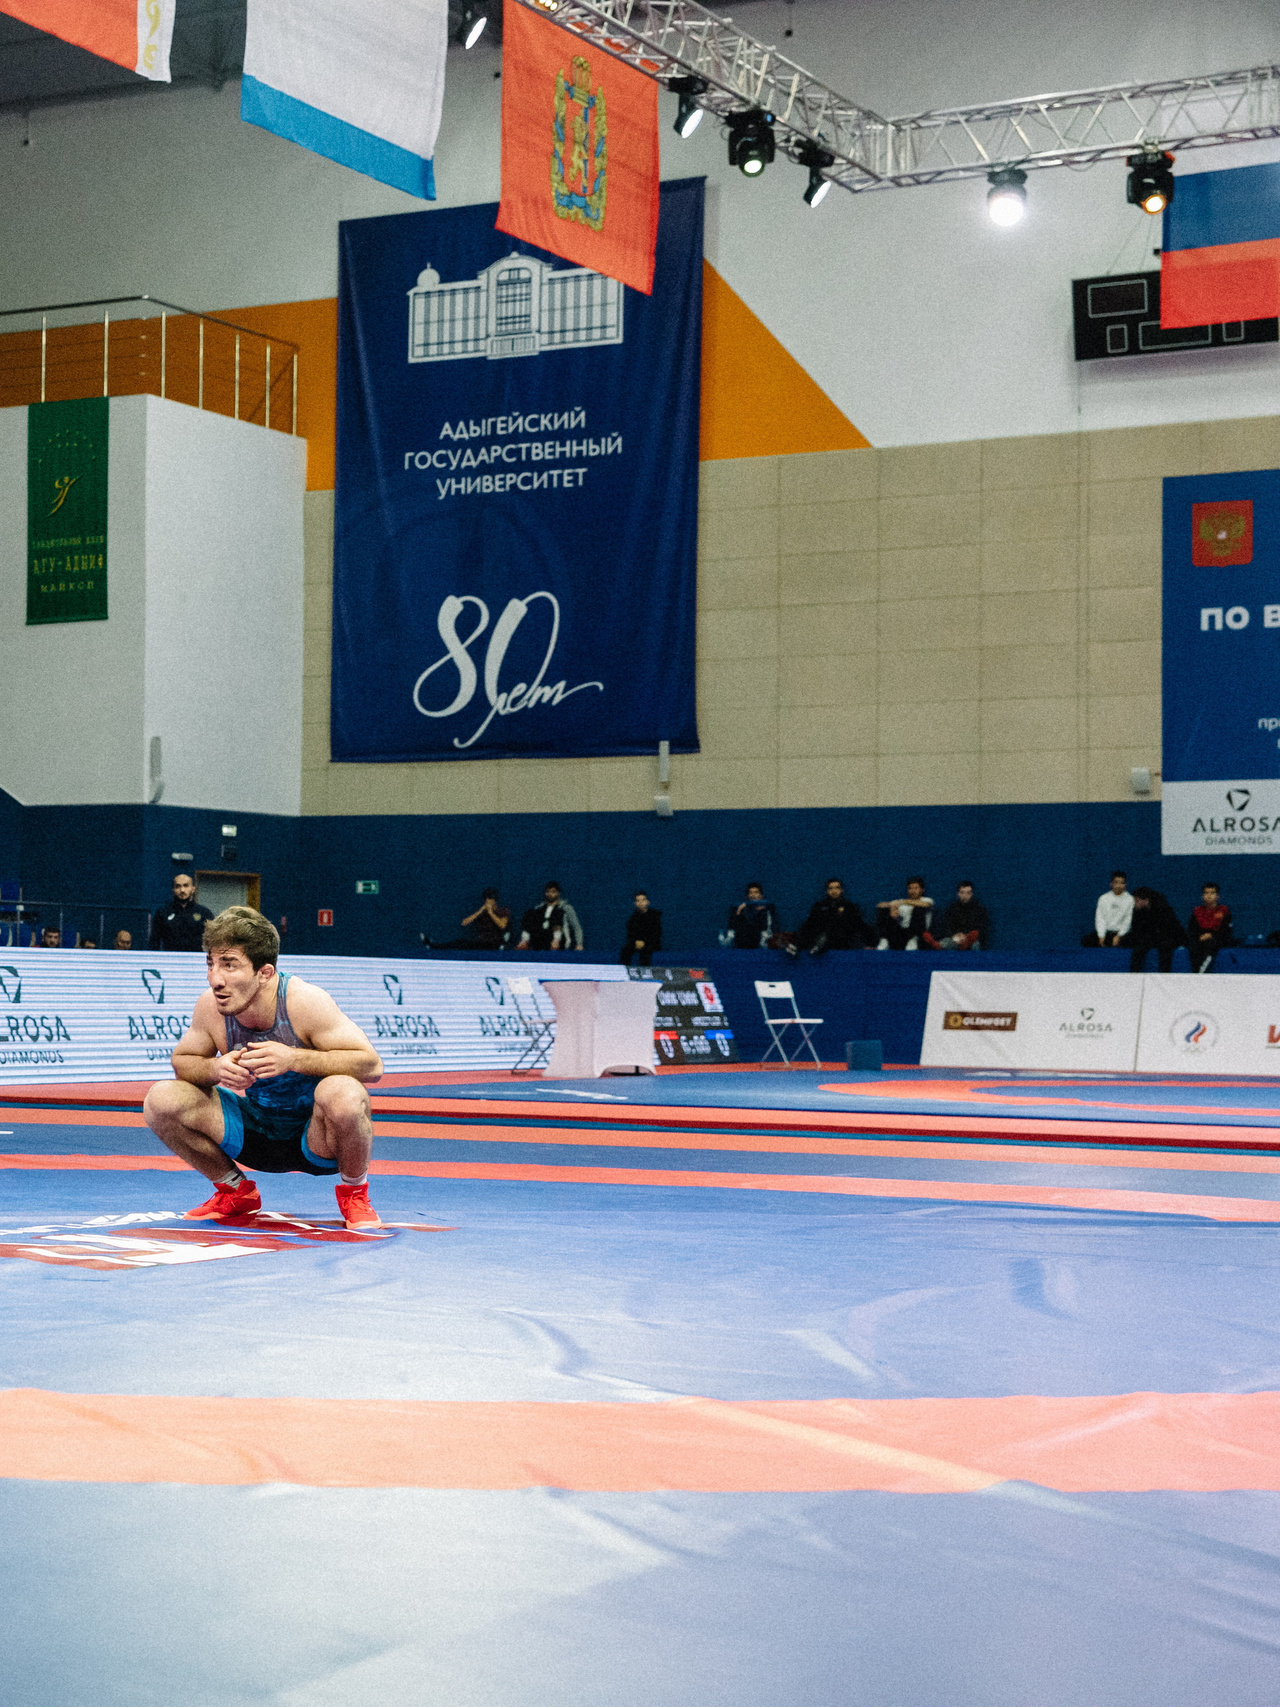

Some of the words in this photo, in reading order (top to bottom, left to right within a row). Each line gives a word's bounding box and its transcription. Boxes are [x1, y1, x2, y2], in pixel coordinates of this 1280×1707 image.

[439, 406, 586, 441] АДЫГЕЙСКИЙ
[404, 431, 623, 471] ГОСУДАРСТВЕННЫЙ
[436, 468, 588, 500] УНИВЕРСИТЕТ
[413, 591, 560, 718] 80
[375, 1014, 441, 1037] ALROSA
[1059, 1022, 1113, 1032] ALROSA
